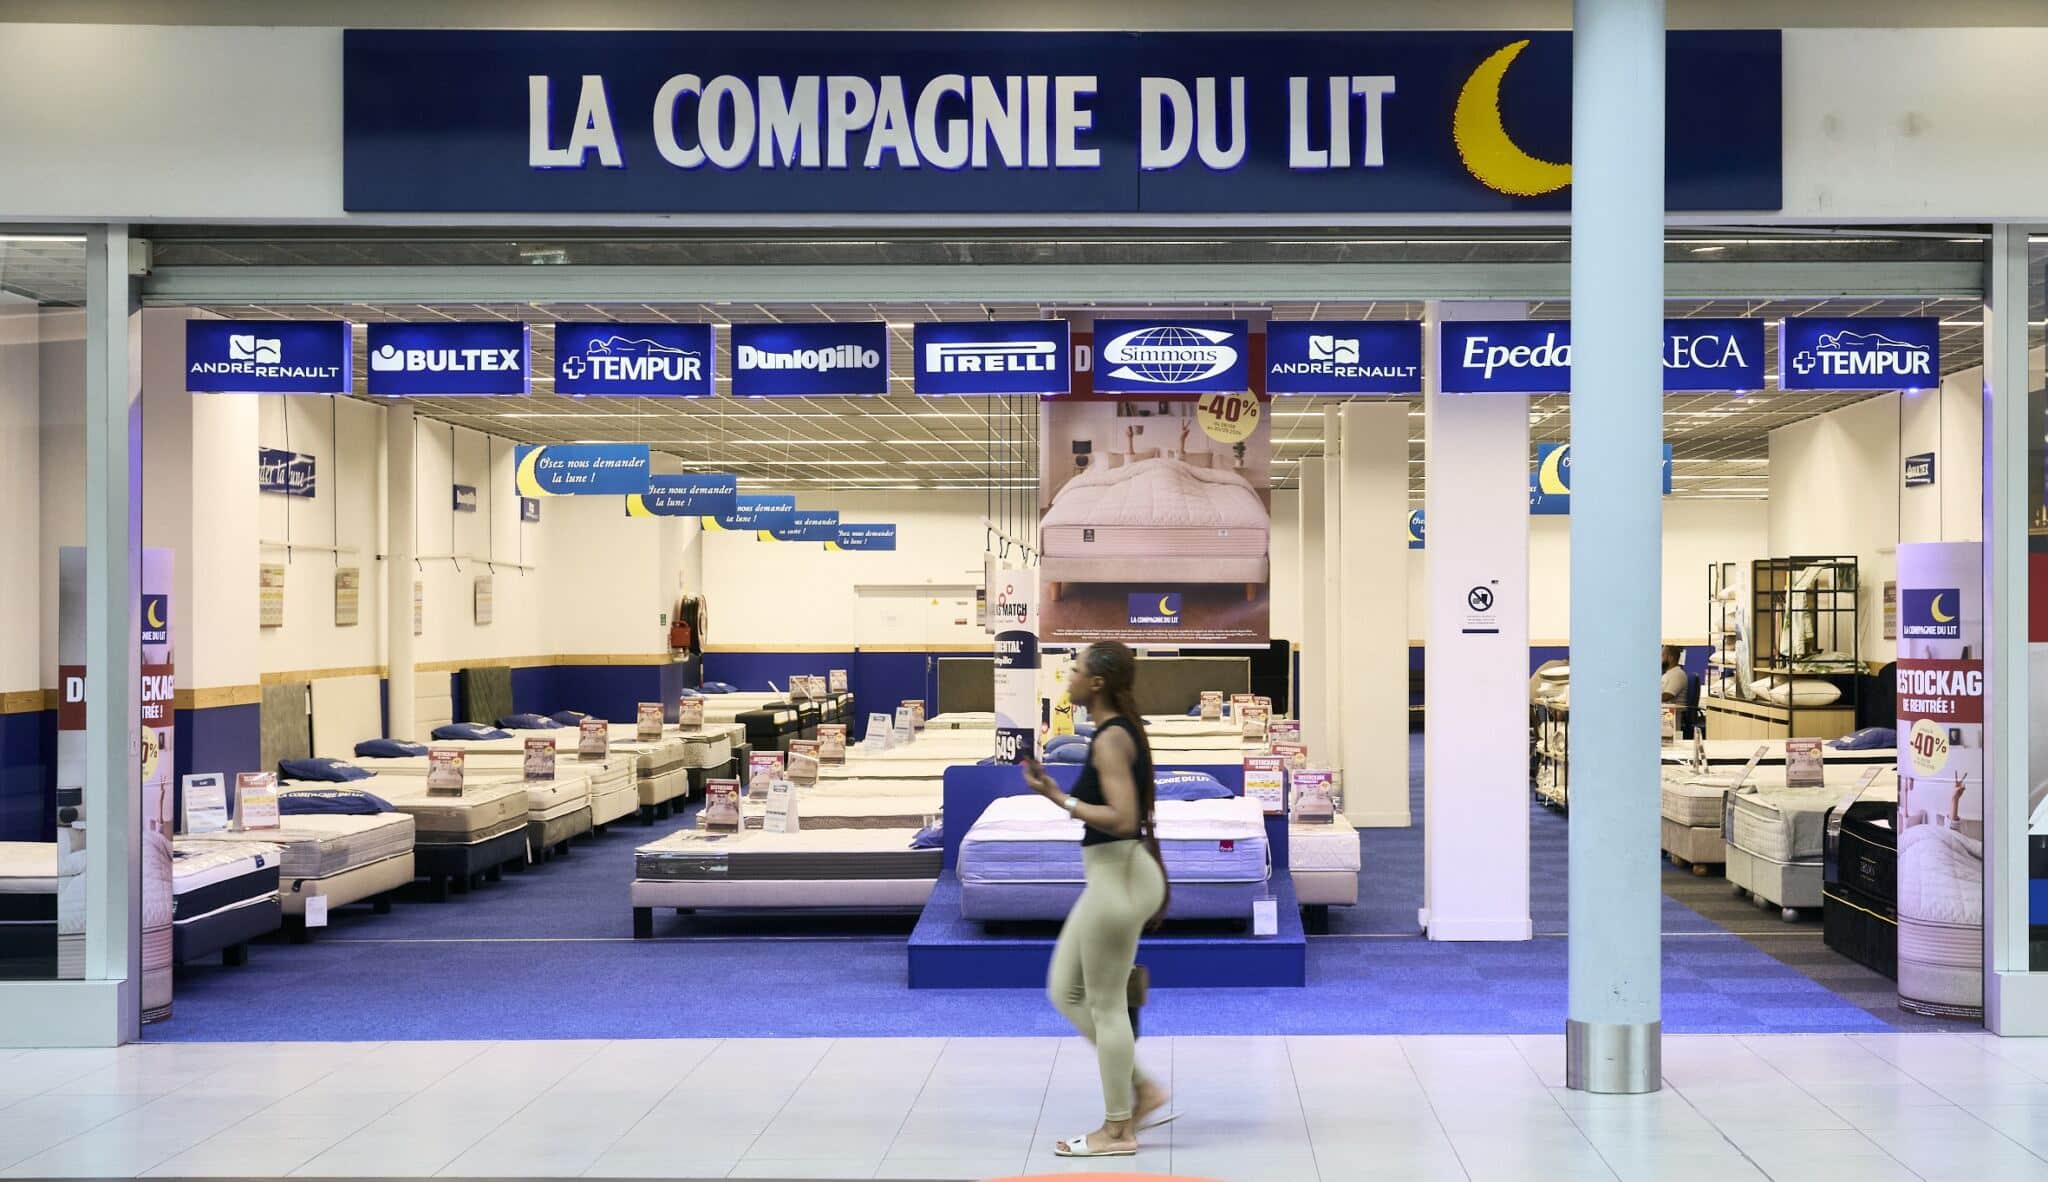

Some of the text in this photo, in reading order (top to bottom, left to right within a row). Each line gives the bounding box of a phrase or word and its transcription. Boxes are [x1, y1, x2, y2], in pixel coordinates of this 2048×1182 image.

[528, 73, 1396, 170] LA COMPAGNIE DU LIT
[406, 349, 520, 372] BULTEX
[738, 345, 880, 372] Dunlopillo
[926, 341, 1057, 373] PIRELLI
[1120, 347, 1217, 362] Simmons
[1462, 332, 1572, 379] Epeda
[588, 356, 702, 381] TEMPUR
[1817, 351, 1931, 375] TEMPUR
[255, 366, 339, 378] RENAULT
[1334, 366, 1417, 378] RENAULT
[1198, 394, 1257, 422] -40%
[567, 459, 590, 468] nous
[592, 456, 646, 468] demander
[551, 472, 562, 483] la
[565, 472, 588, 483] lune
[667, 486, 688, 495] nous
[689, 484, 734, 495] demander
[655, 497, 664, 507] la
[666, 497, 686, 507] lune
[754, 503, 793, 512] demander
[804, 517, 837, 526] demander
[1003, 603, 1027, 616] MATCH
[1937, 625, 1947, 635] DU
[1947, 625, 1958, 635] LIT
[1910, 697, 1949, 714] RENTRÉE
[1950, 700, 1956, 714] !
[1910, 732, 1947, 758] -40%
[1179, 776, 1196, 784] DU
